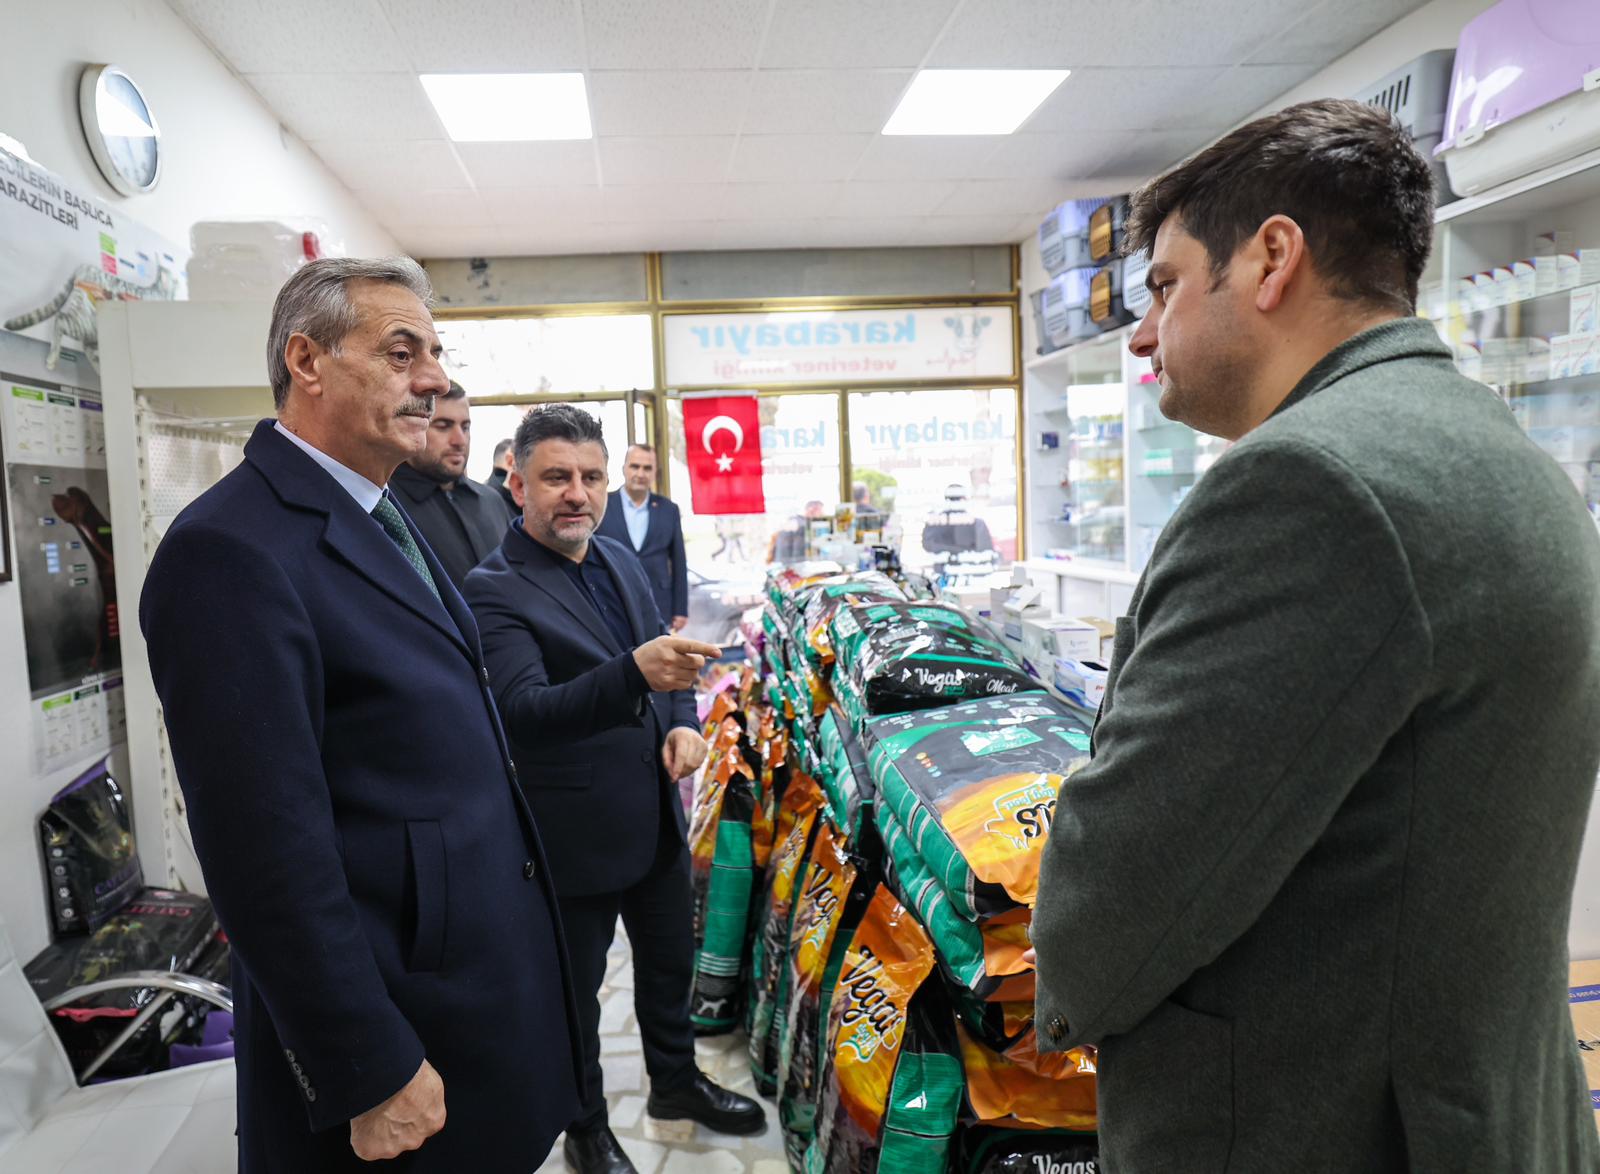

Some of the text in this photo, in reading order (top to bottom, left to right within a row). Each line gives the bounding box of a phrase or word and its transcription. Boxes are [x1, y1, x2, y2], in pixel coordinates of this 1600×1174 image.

[64, 188, 113, 228] BAŞLICA
[914, 667, 963, 693] Vegas
[986, 679, 1018, 694] Meat
[803, 863, 840, 930] Veg
